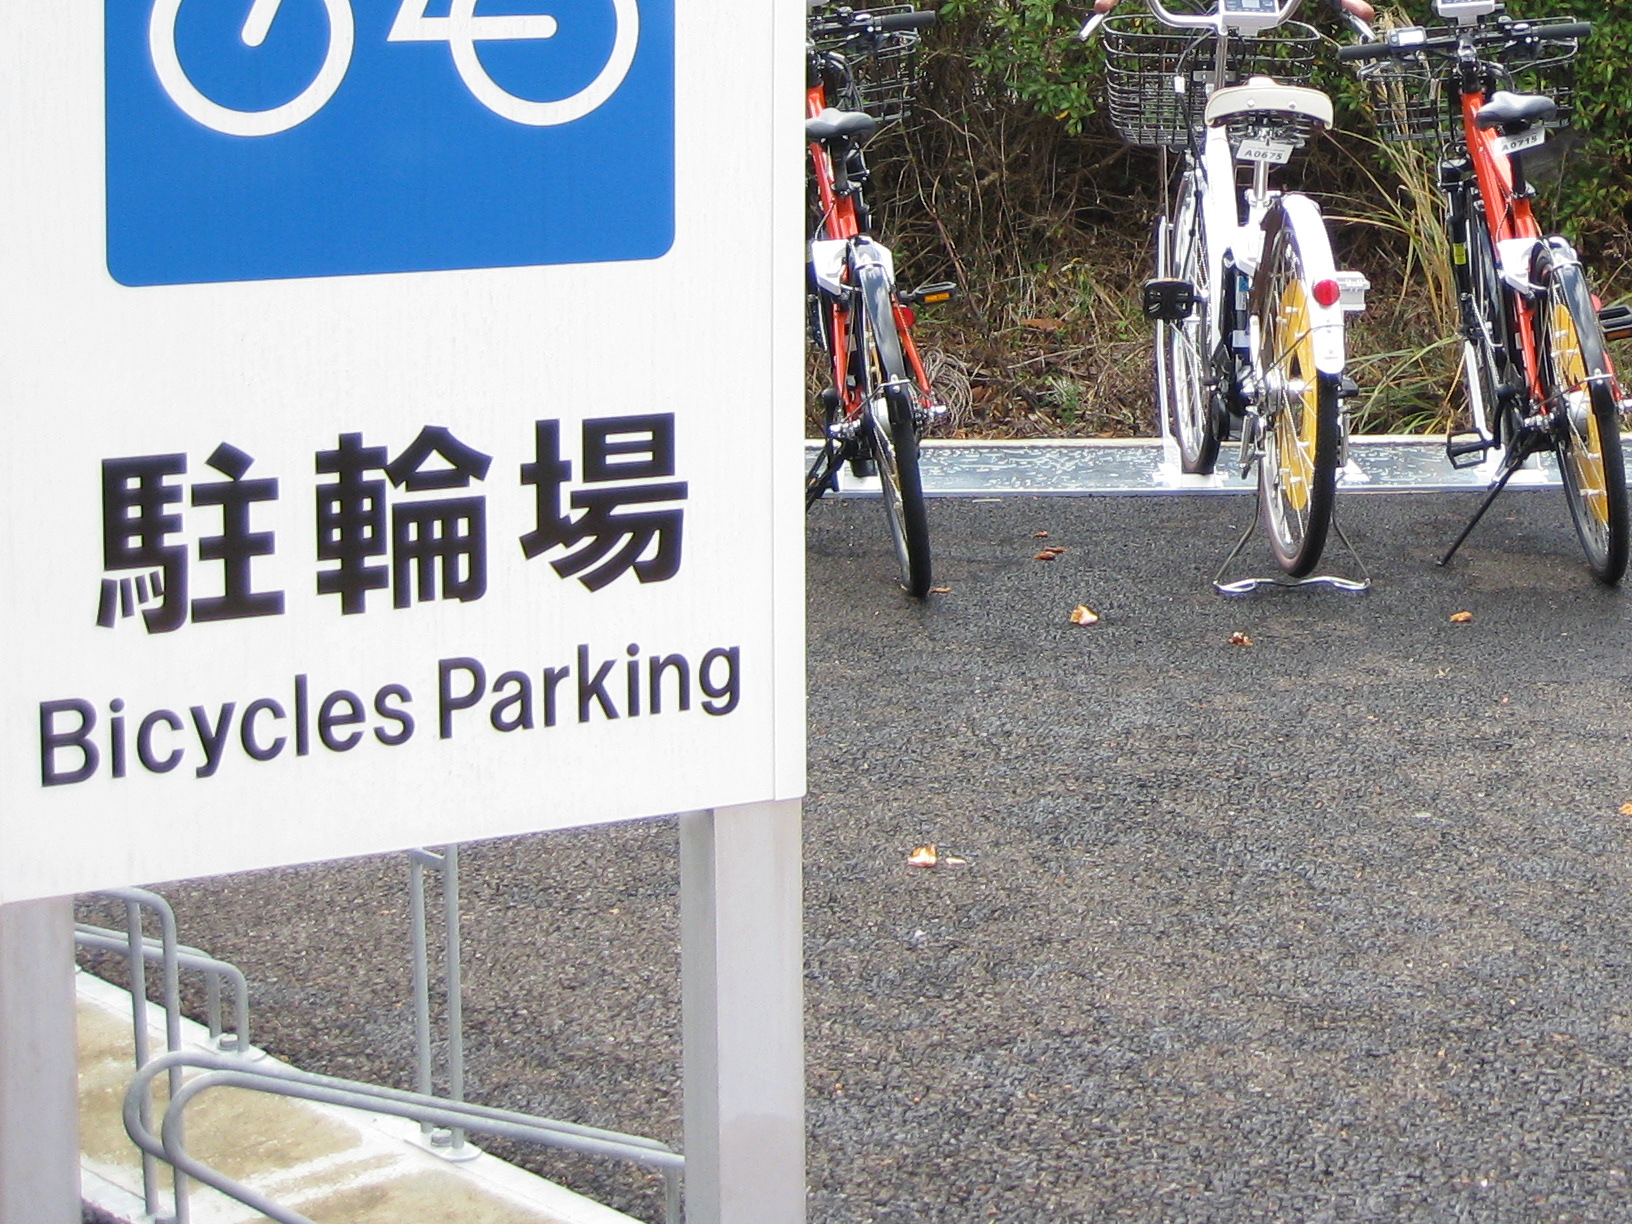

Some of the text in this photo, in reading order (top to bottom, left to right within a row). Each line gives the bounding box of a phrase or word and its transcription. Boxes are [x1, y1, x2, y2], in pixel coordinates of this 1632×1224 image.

[1243, 149, 1283, 160] A0675
[96, 411, 690, 634] 駐輪場
[39, 643, 741, 787] Bicycles Parking
